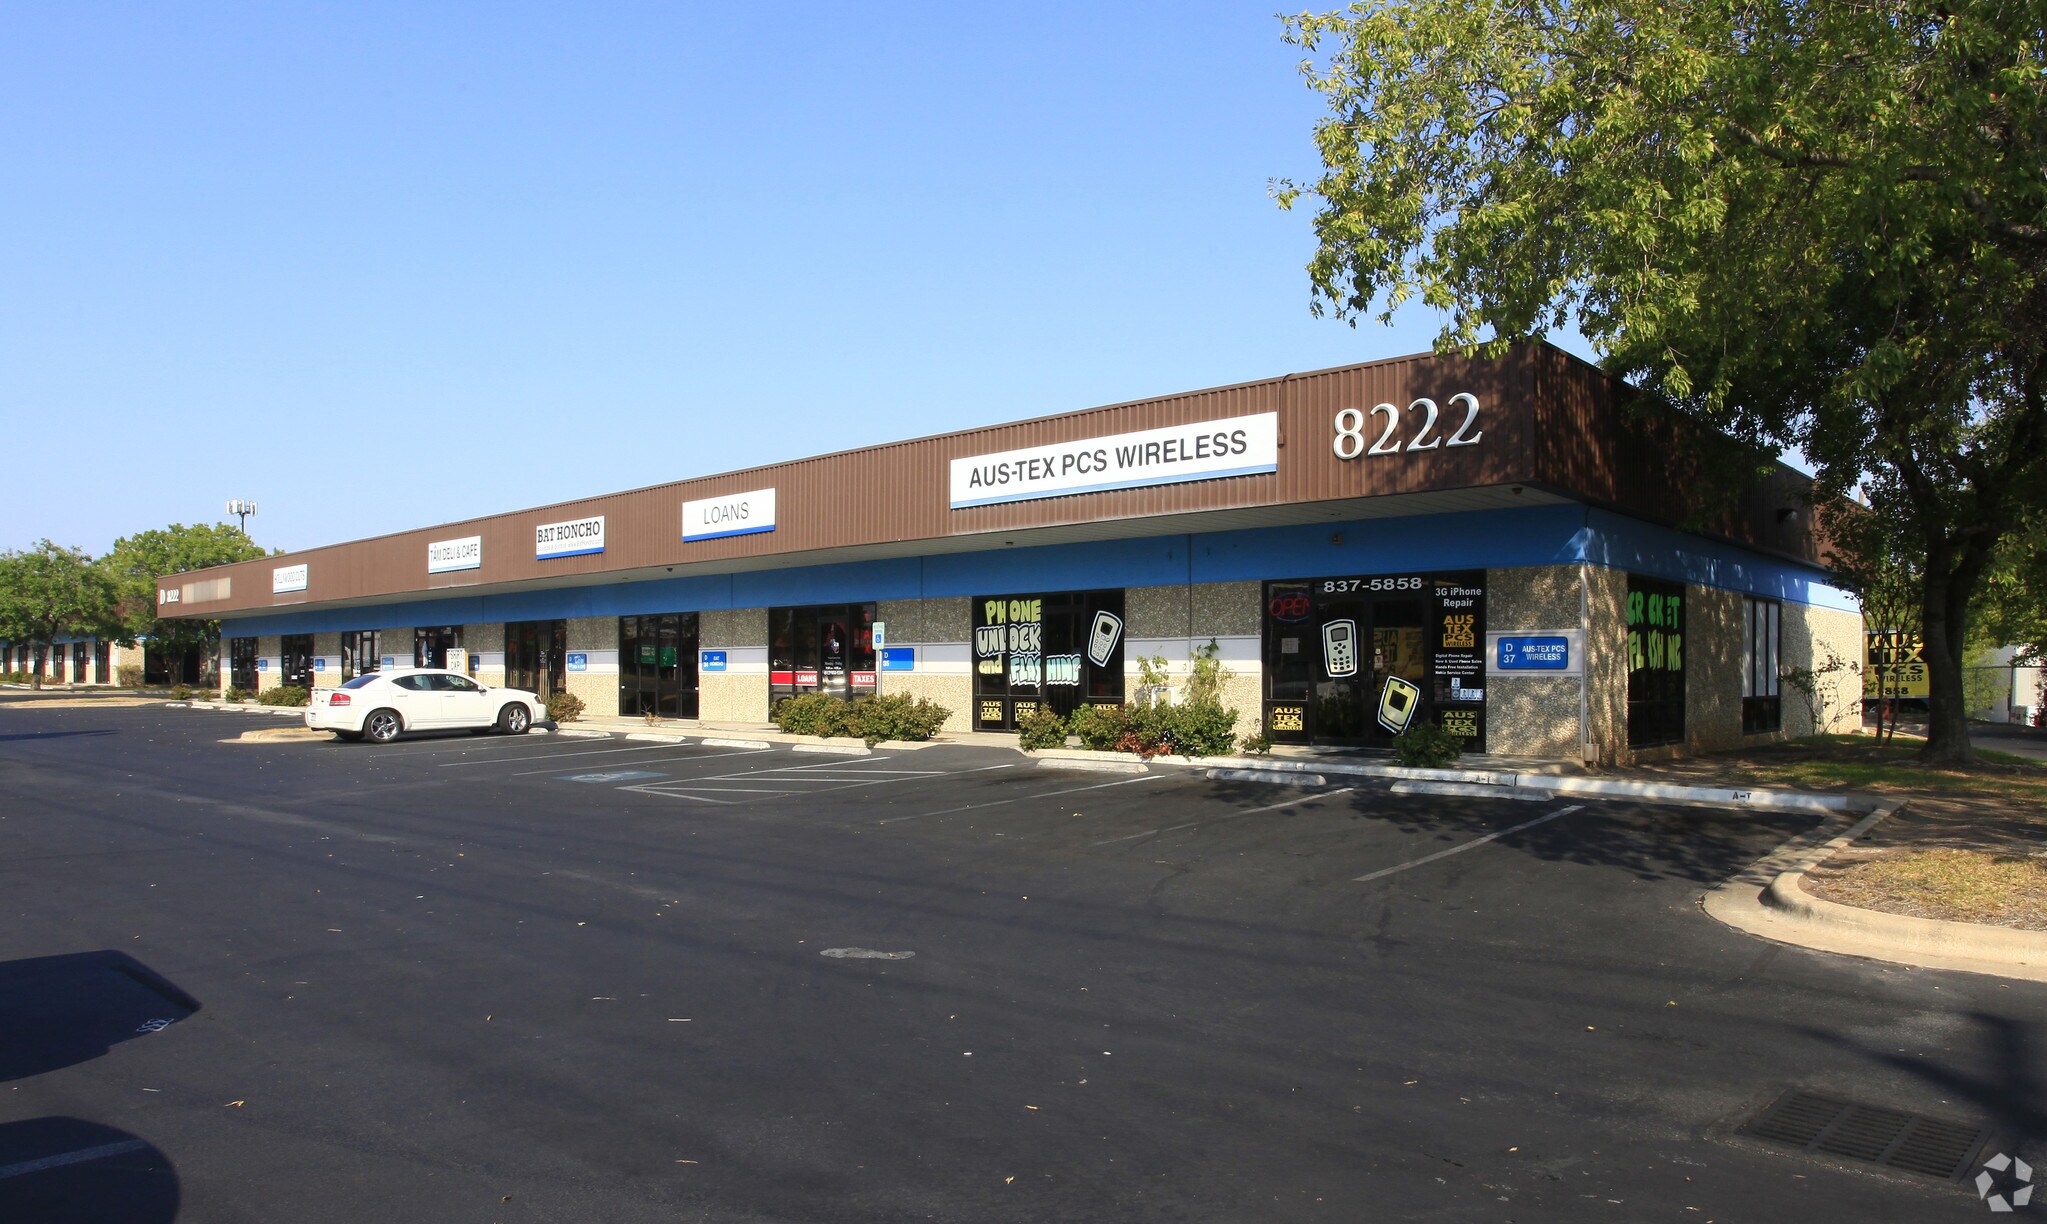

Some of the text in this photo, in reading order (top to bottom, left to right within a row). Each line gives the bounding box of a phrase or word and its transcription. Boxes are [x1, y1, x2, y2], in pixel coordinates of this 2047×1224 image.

[1333, 392, 1483, 460] 8222
[969, 430, 1248, 489] AUS-TEX PCS WIRELESS
[703, 502, 749, 525] LOANS
[537, 521, 600, 543] BAT HONCHO
[443, 547, 456, 560] DELI
[457, 546, 461, 558] &
[462, 543, 478, 558] CAFE
[1323, 577, 1422, 593] 837-5858
[1435, 587, 1482, 596] 3G iPhone
[160, 589, 166, 605] D
[1443, 598, 1474, 608] Repair
[985, 600, 1041, 625] PHONE
[1628, 591, 1680, 630] CRCKET
[1443, 615, 1474, 625] AUS
[1445, 624, 1472, 634] TEX
[977, 624, 1041, 656] UNLOCK
[1505, 643, 1513, 652] D
[1522, 645, 1566, 653] AUS-TEX PCS
[1526, 653, 1561, 661] WIRELESS
[1628, 629, 1681, 673] FLSHNG
[979, 654, 1003, 674] and
[1503, 654, 1516, 663] 37
[797, 675, 817, 683] LOANS
[853, 674, 875, 683] TAXES
[1732, 791, 1752, 801] A-T
